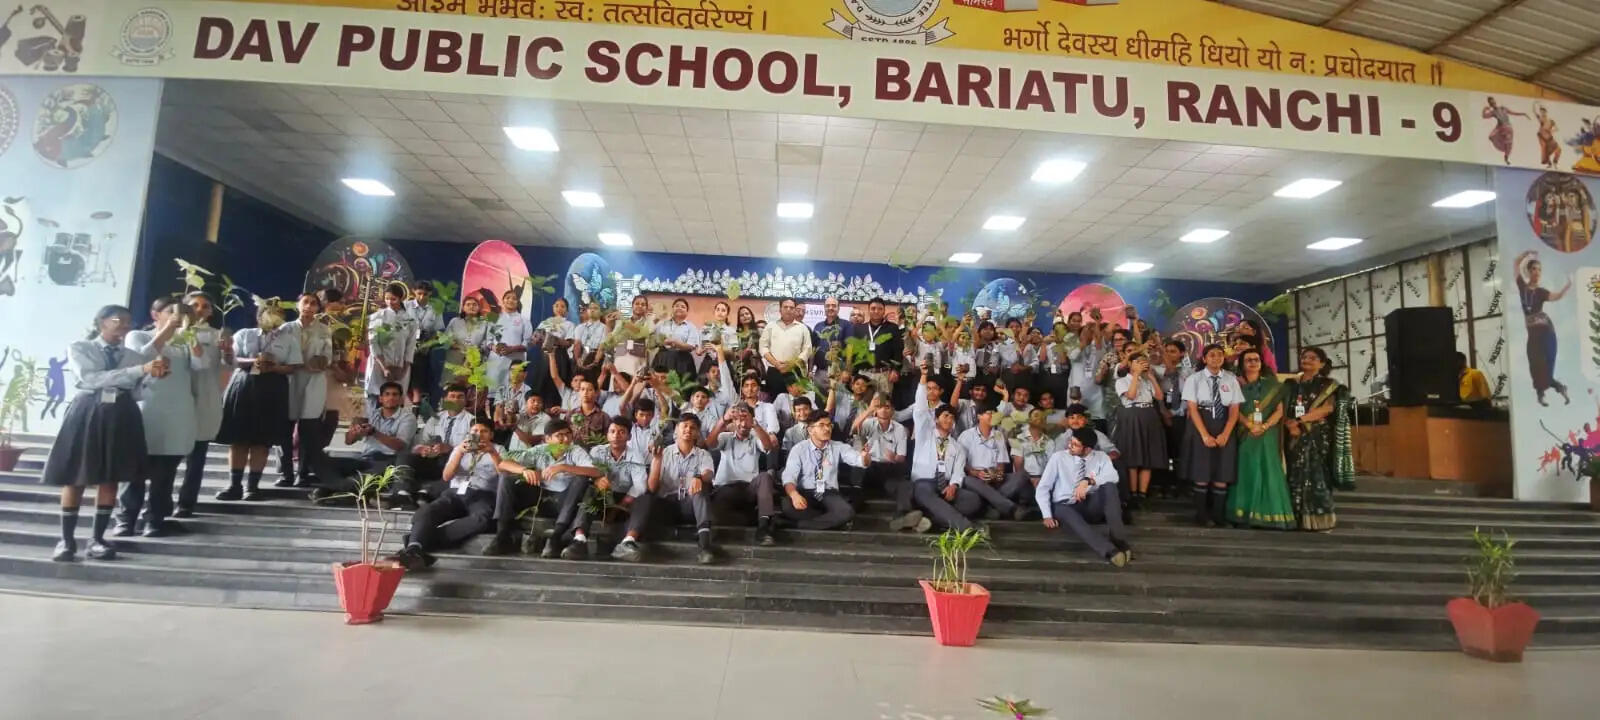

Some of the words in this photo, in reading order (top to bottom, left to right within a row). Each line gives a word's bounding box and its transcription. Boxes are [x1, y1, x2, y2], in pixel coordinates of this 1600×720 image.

[193, 16, 320, 64] DAV
[336, 25, 565, 81] PUBLIC
[584, 40, 851, 108] SCHOOL,
[875, 58, 1146, 130] BARIATU,
[1167, 81, 1382, 137] RANCHI
[1433, 101, 1463, 143] 9
[1003, 20, 1051, 51] भर्गो
[1057, 22, 1119, 57] देवस्य
[1126, 29, 1193, 66] धीमहि
[1199, 35, 1249, 68] धियो
[1257, 40, 1282, 71] यो
